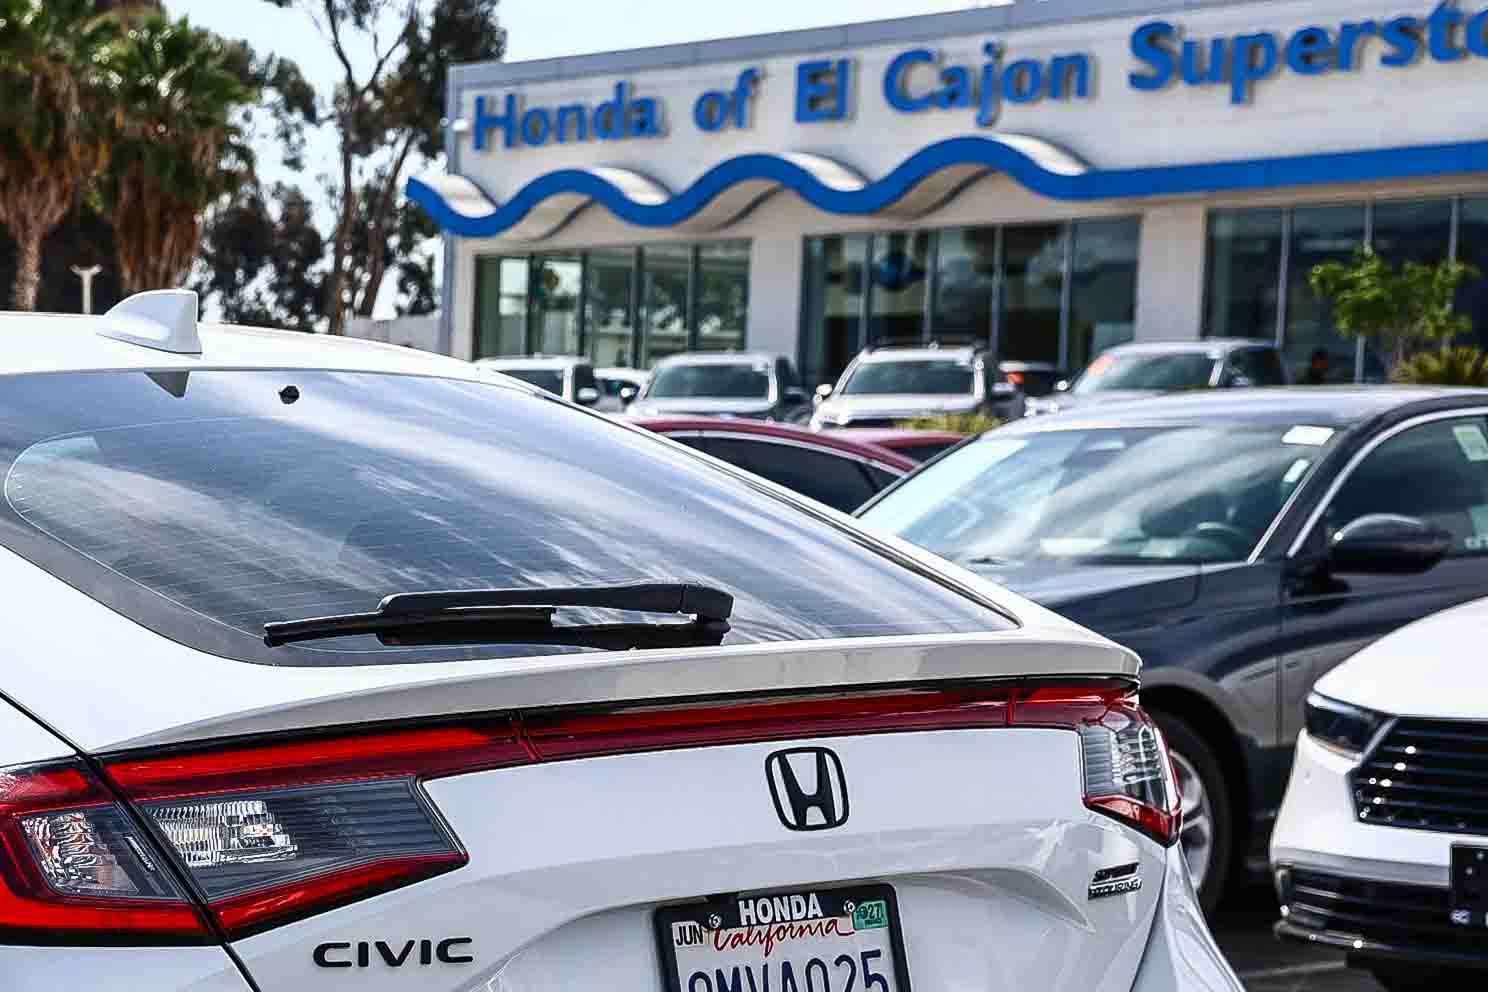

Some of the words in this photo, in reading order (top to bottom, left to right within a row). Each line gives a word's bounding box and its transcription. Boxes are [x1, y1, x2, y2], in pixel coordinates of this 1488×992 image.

[473, 81, 664, 151] Honda
[693, 67, 762, 131] of
[795, 59, 851, 123] El
[883, 42, 1092, 127] Cajon
[738, 893, 824, 925] HONDA
[675, 925, 704, 946] JUN
[710, 915, 855, 957] California
[313, 937, 474, 968] CIVIC
